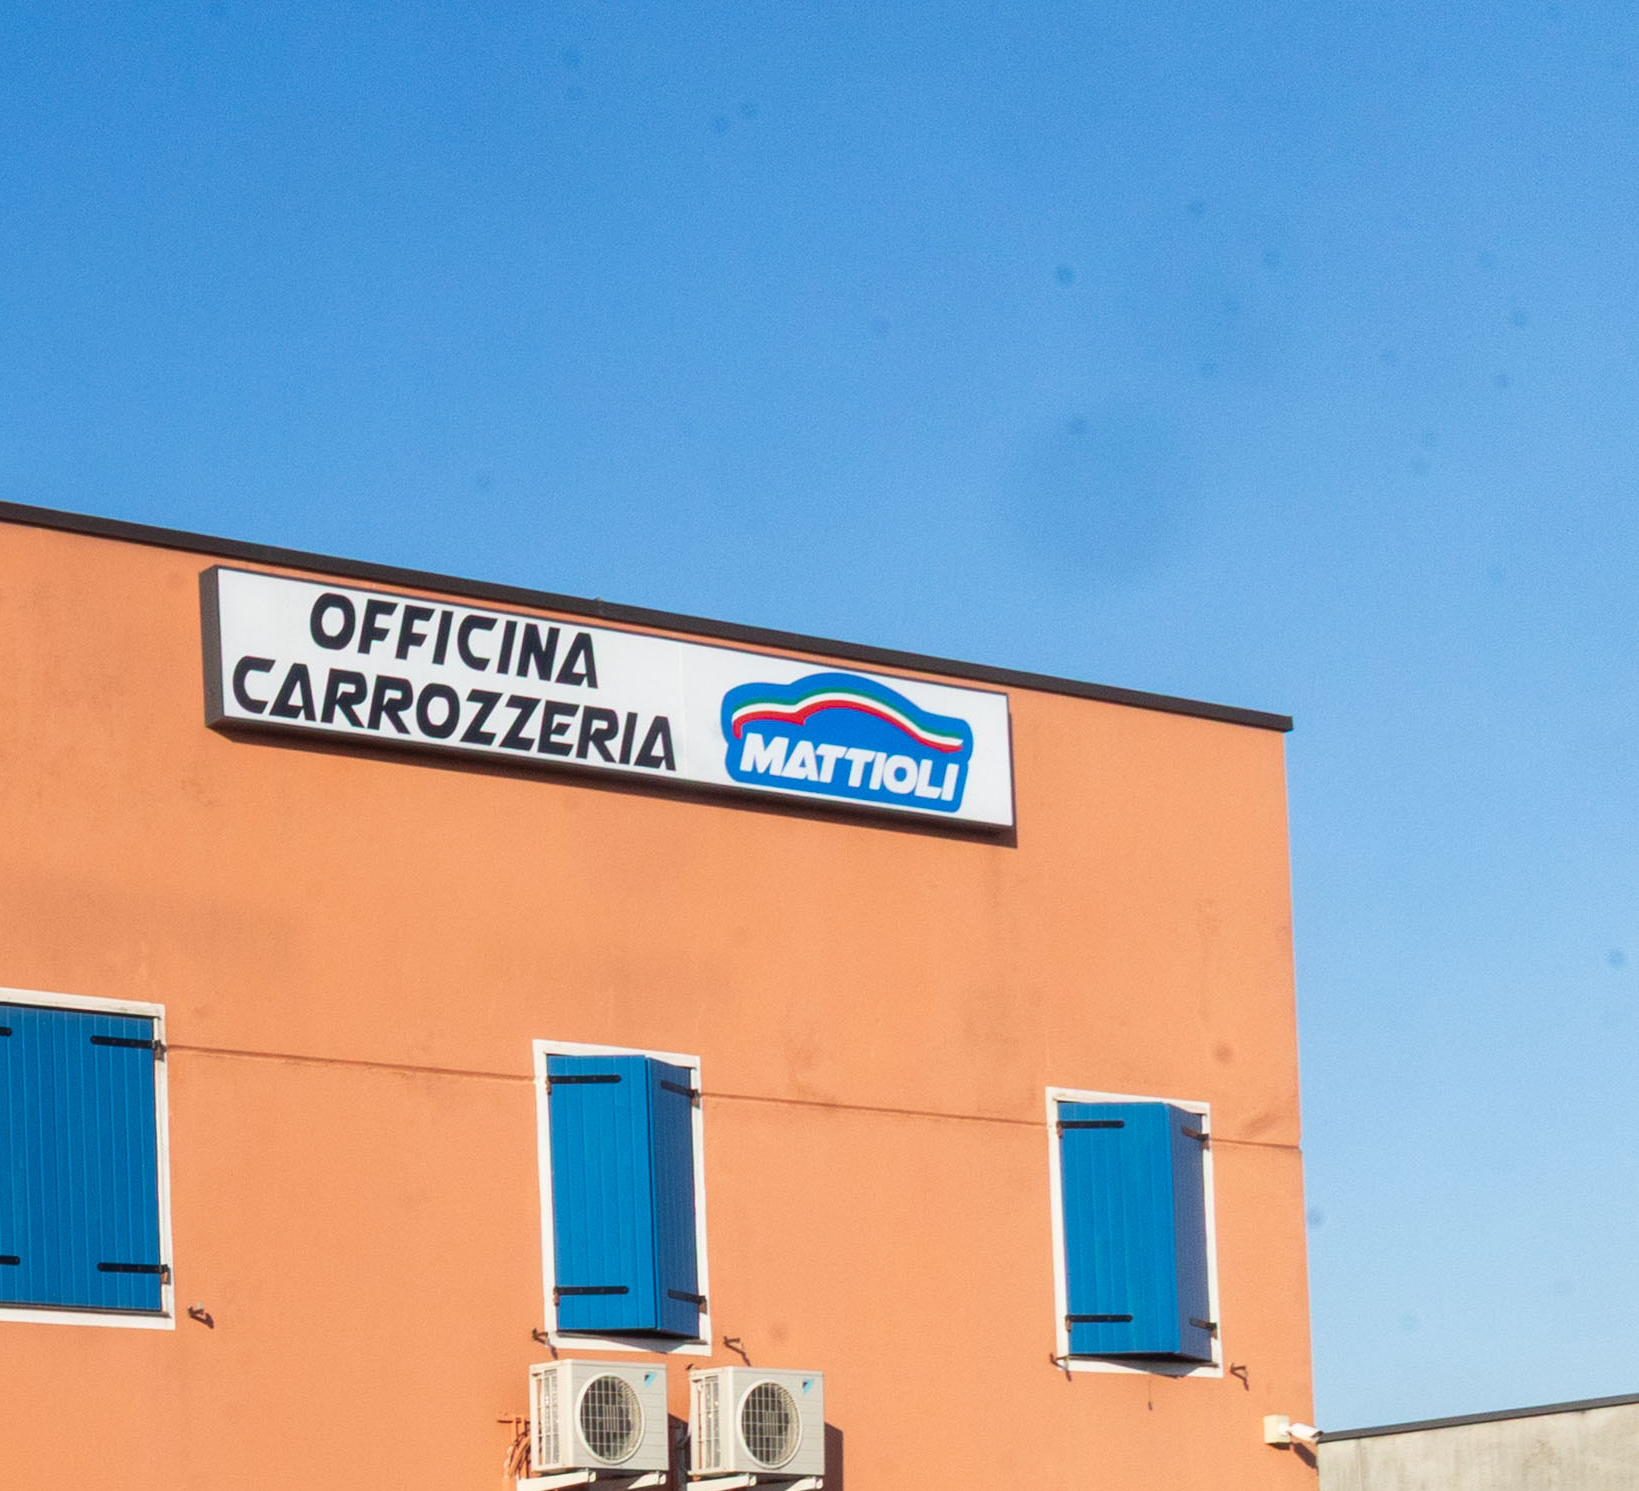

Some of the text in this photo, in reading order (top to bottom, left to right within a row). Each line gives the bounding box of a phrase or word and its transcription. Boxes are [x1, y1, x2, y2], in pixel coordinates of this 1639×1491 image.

[309, 592, 599, 689] OFFICINA
[232, 655, 678, 772] CARROZZERIA
[738, 731, 961, 803] MATTIOLI
